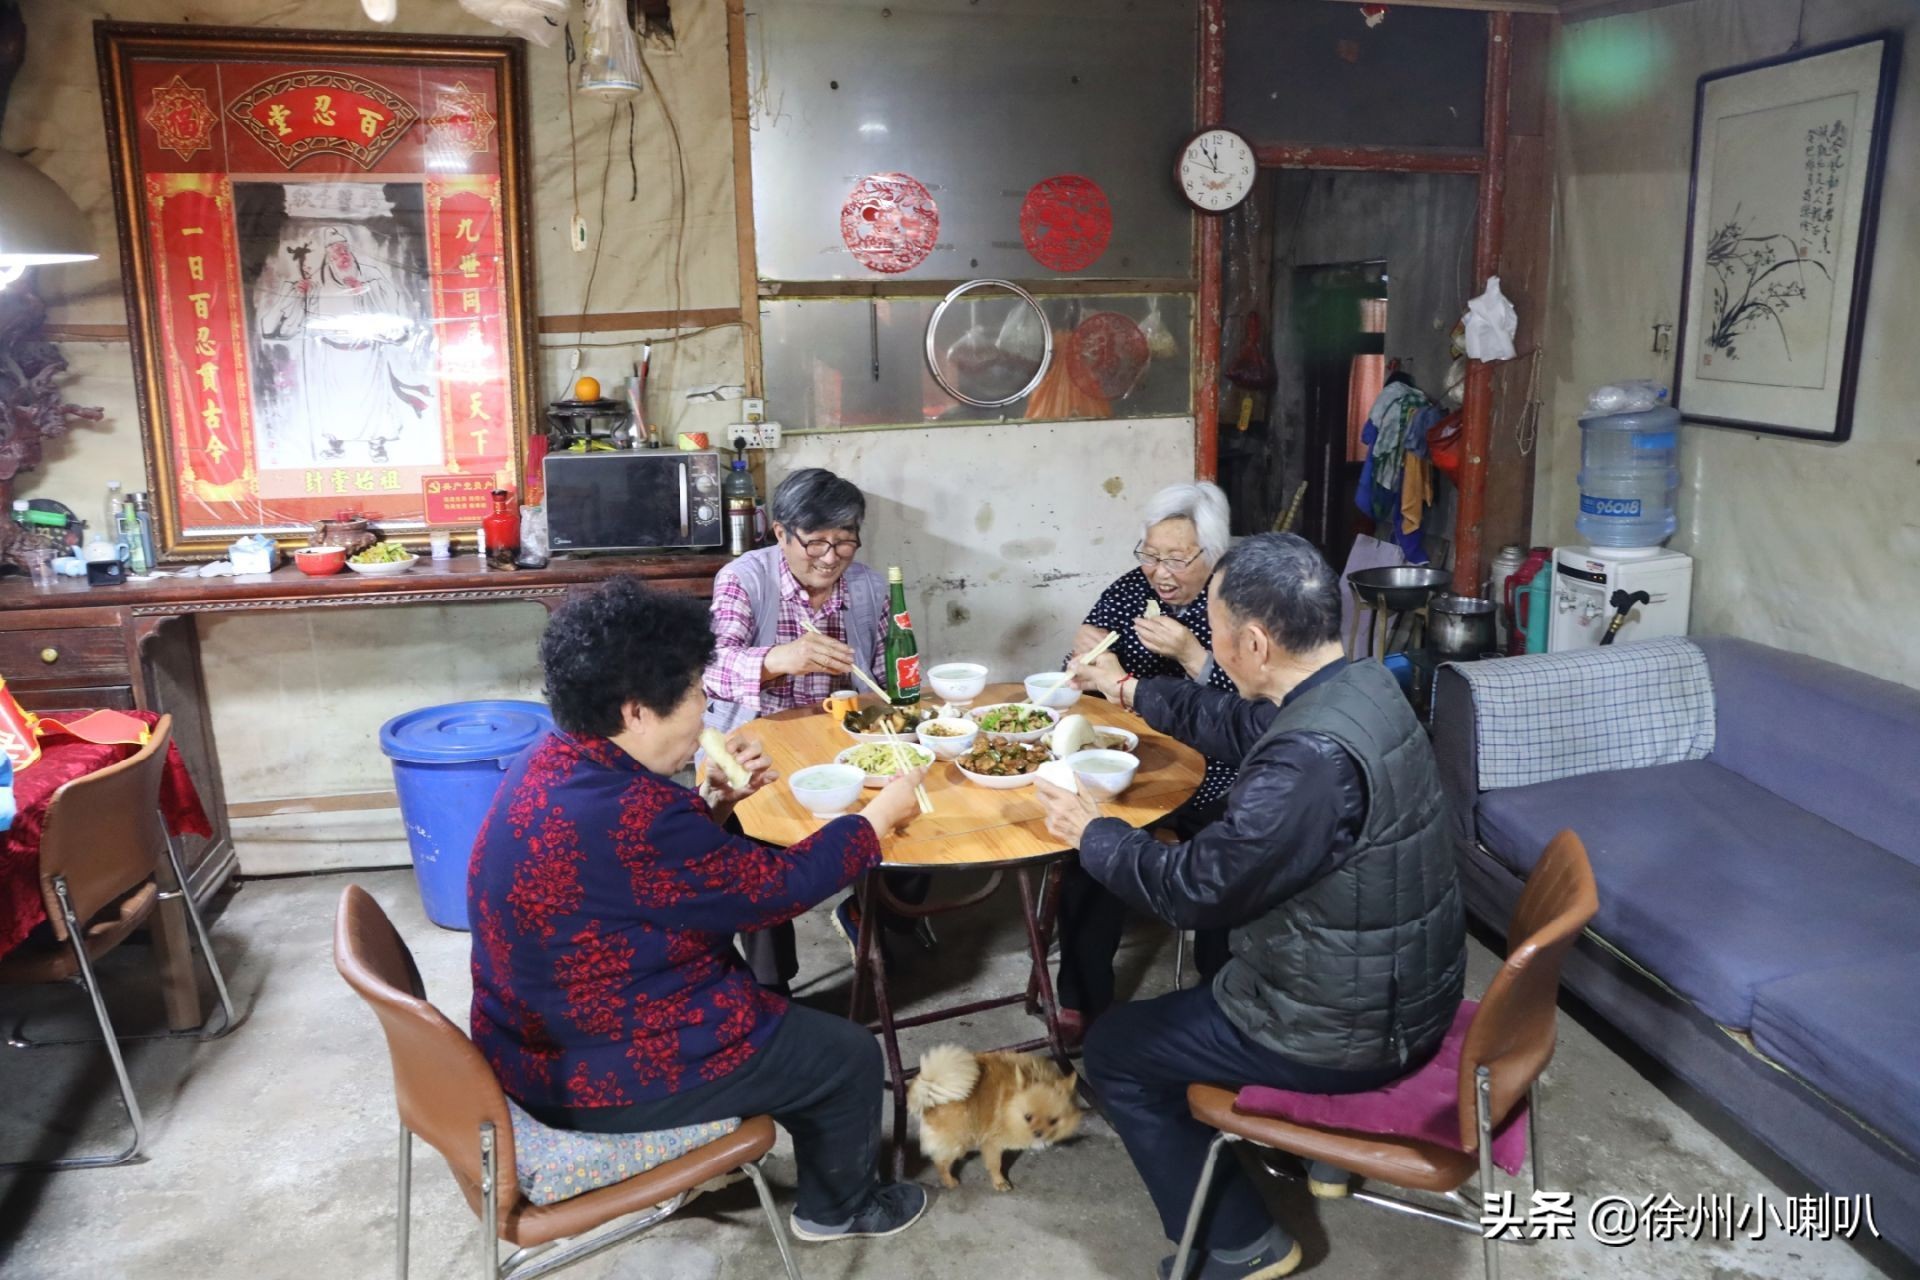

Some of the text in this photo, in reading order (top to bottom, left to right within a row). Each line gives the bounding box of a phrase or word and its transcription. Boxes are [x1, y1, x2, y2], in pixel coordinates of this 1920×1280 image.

[1212, 134, 1224, 145] 12
[456, 218, 491, 456] 九世同天下
